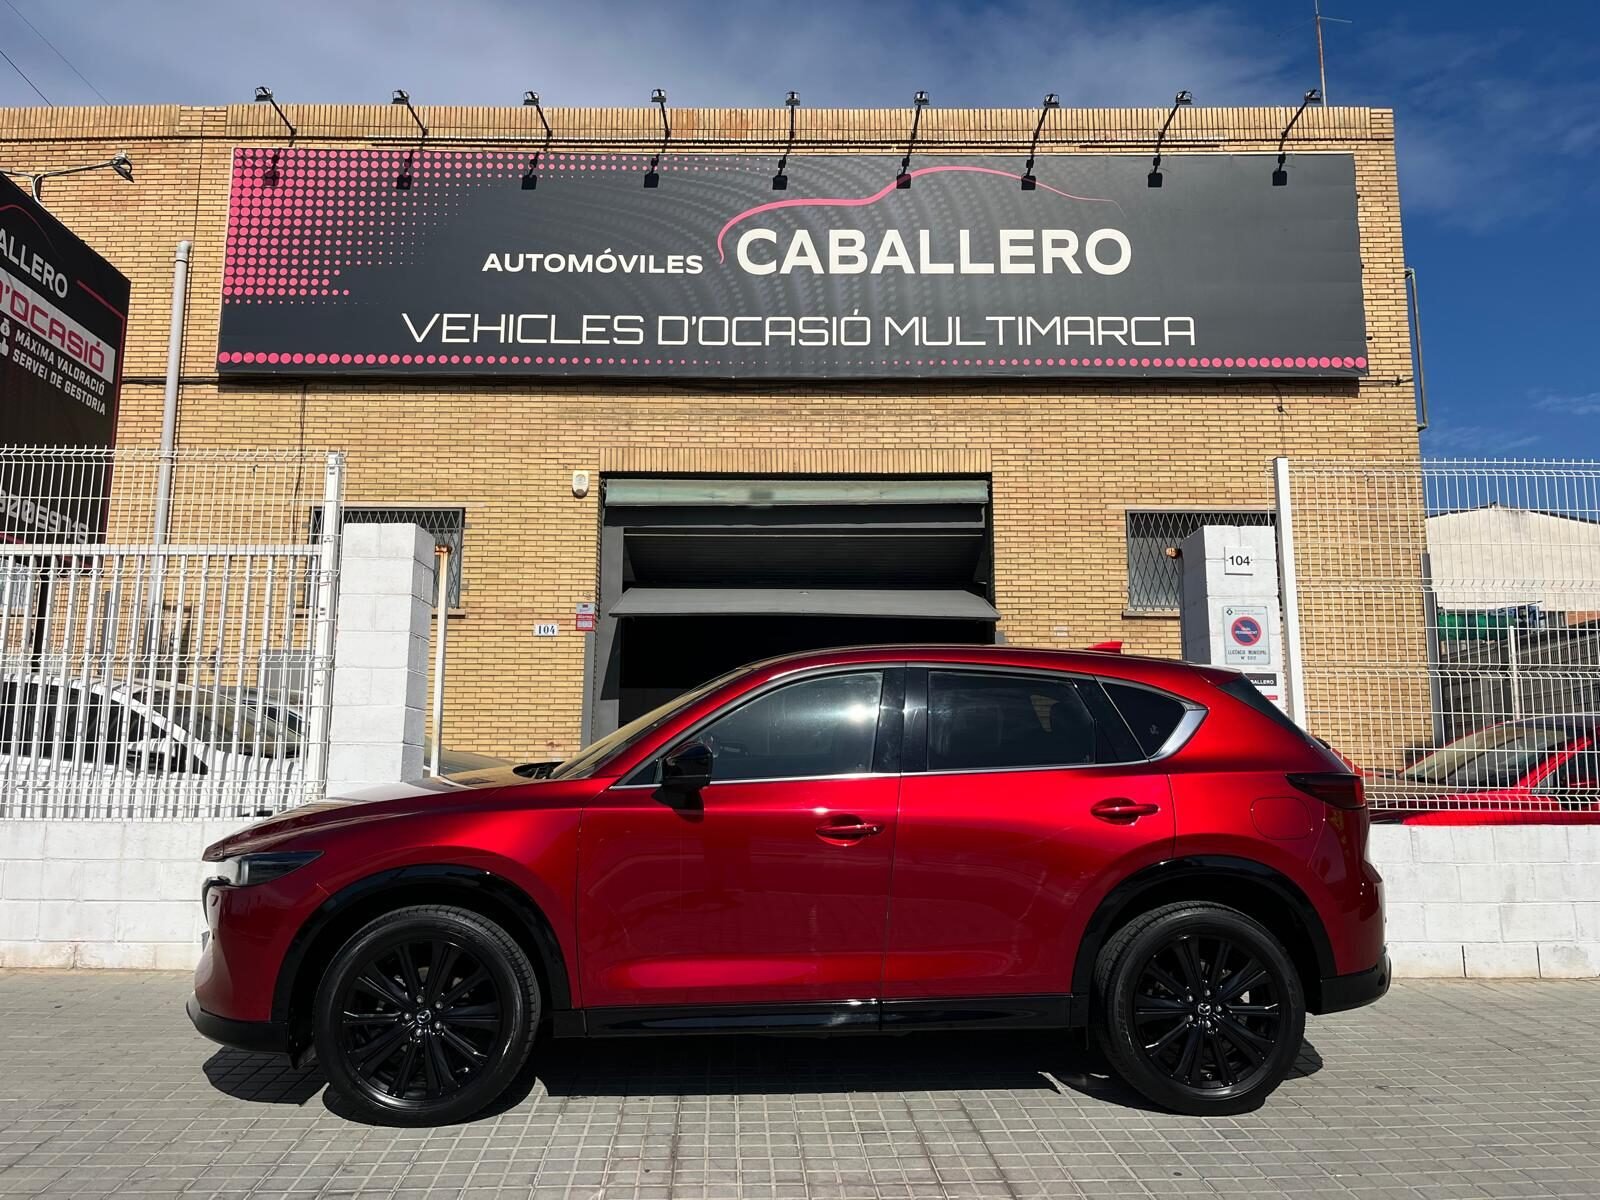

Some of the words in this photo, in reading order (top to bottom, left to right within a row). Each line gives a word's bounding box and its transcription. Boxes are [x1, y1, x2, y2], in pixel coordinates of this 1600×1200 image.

[481, 248, 704, 275] AUTOMÓVILES
[736, 228, 1132, 276] CABALLERO
[0, 281, 104, 373] 'OCASIÓ
[401, 313, 644, 346] VEHICLES
[657, 308, 871, 347] D'OCASIÓ
[884, 315, 1196, 347] MULTIMARCA
[12, 348, 48, 380] SERVEI
[49, 371, 63, 389] DE
[64, 380, 105, 416] GESTORIA
[57, 356, 105, 396] VALORACIÓ
[1228, 555, 1251, 566] 104
[538, 625, 555, 635] 104
